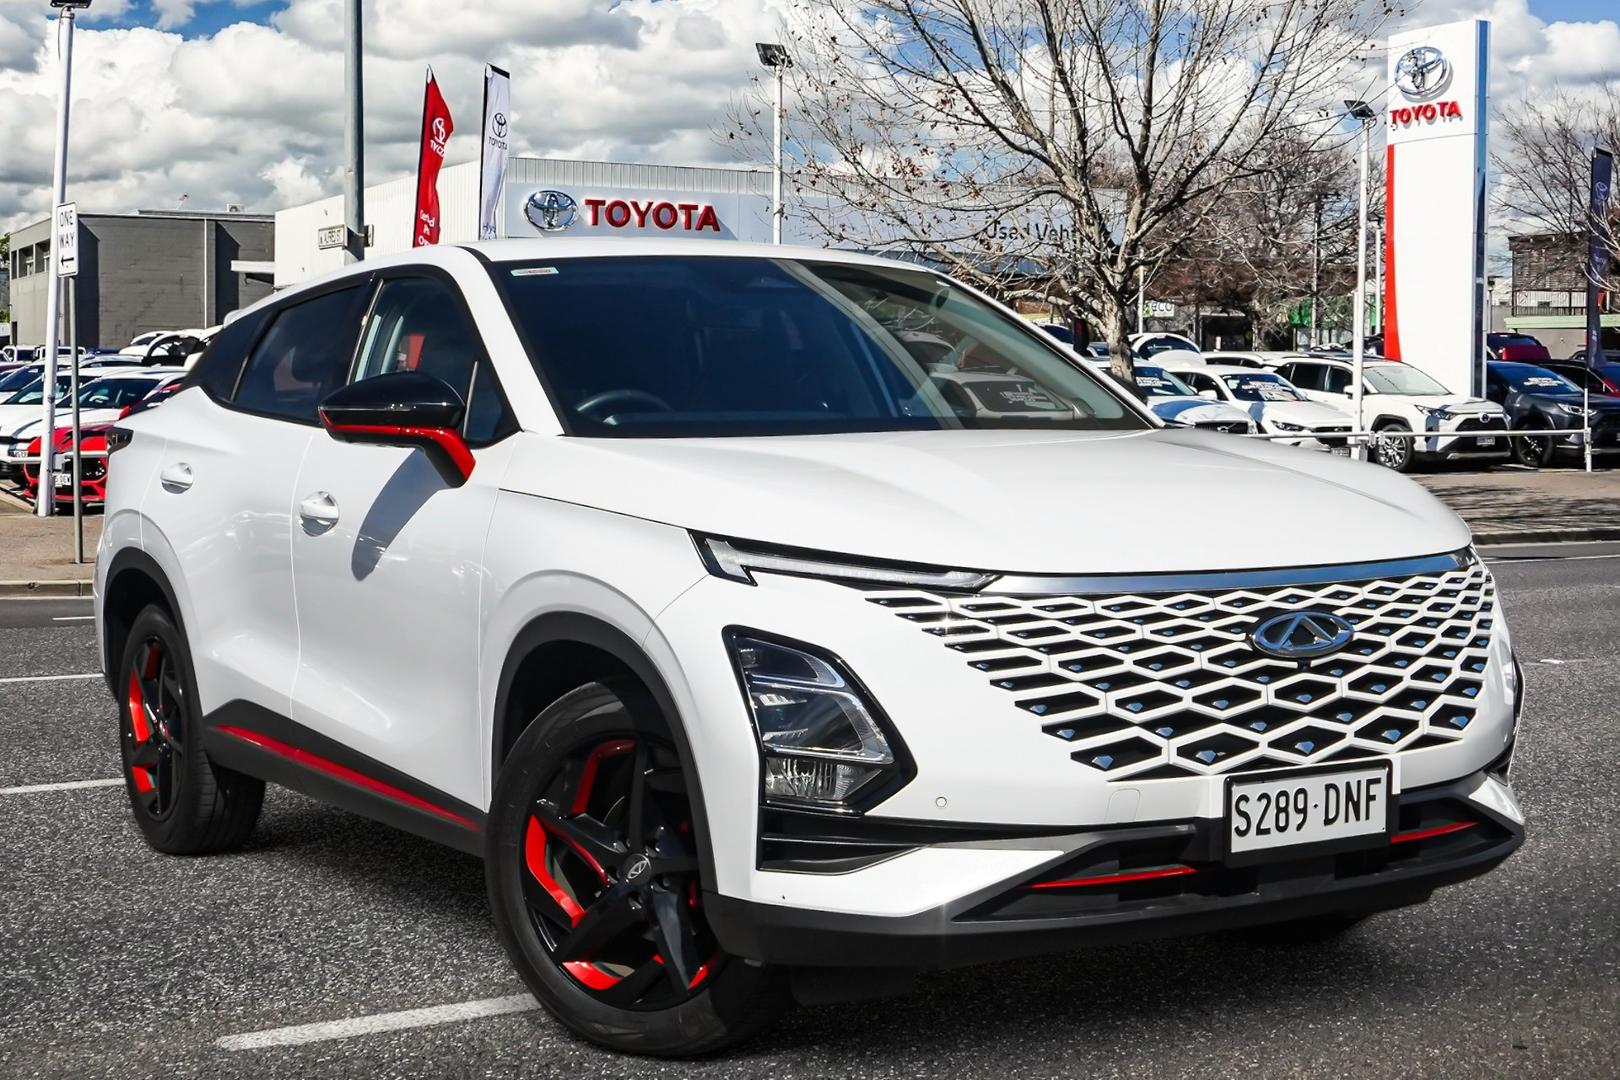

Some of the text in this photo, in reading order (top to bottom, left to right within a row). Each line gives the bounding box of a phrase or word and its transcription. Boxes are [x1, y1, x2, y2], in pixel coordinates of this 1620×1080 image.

[1389, 100, 1462, 125] TOYOTA
[488, 136, 508, 151] TOYOTA
[60, 209, 74, 227] ONE
[584, 198, 721, 232] TOYOTA
[985, 219, 1030, 240] Used
[59, 231, 75, 249] WAY
